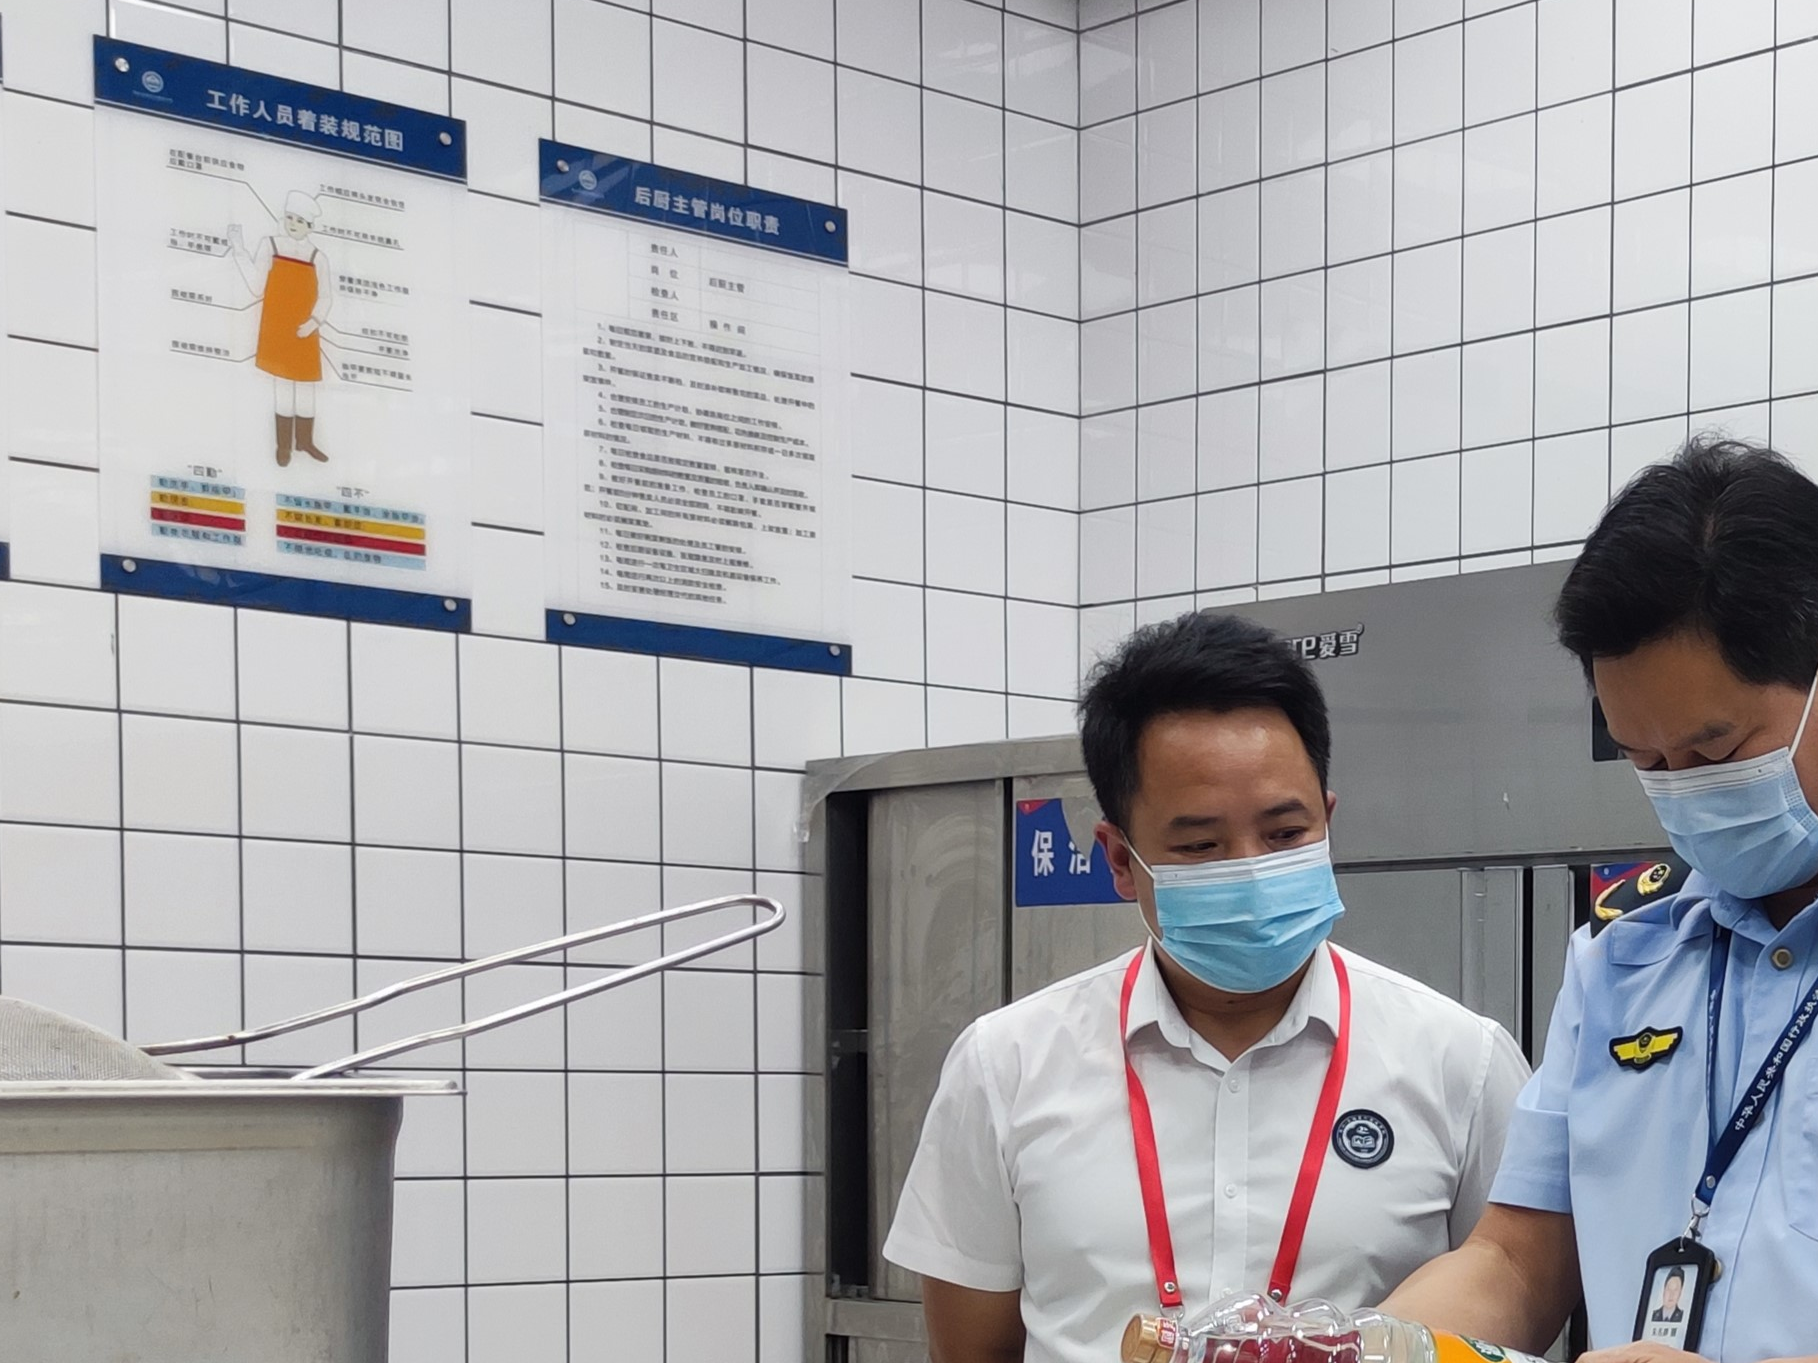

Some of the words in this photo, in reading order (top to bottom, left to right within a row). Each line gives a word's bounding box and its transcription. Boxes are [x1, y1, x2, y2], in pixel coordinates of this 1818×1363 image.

[206, 89, 404, 152] 工作人员着装规范图
[634, 186, 781, 235] 后厨主管岗位职责
